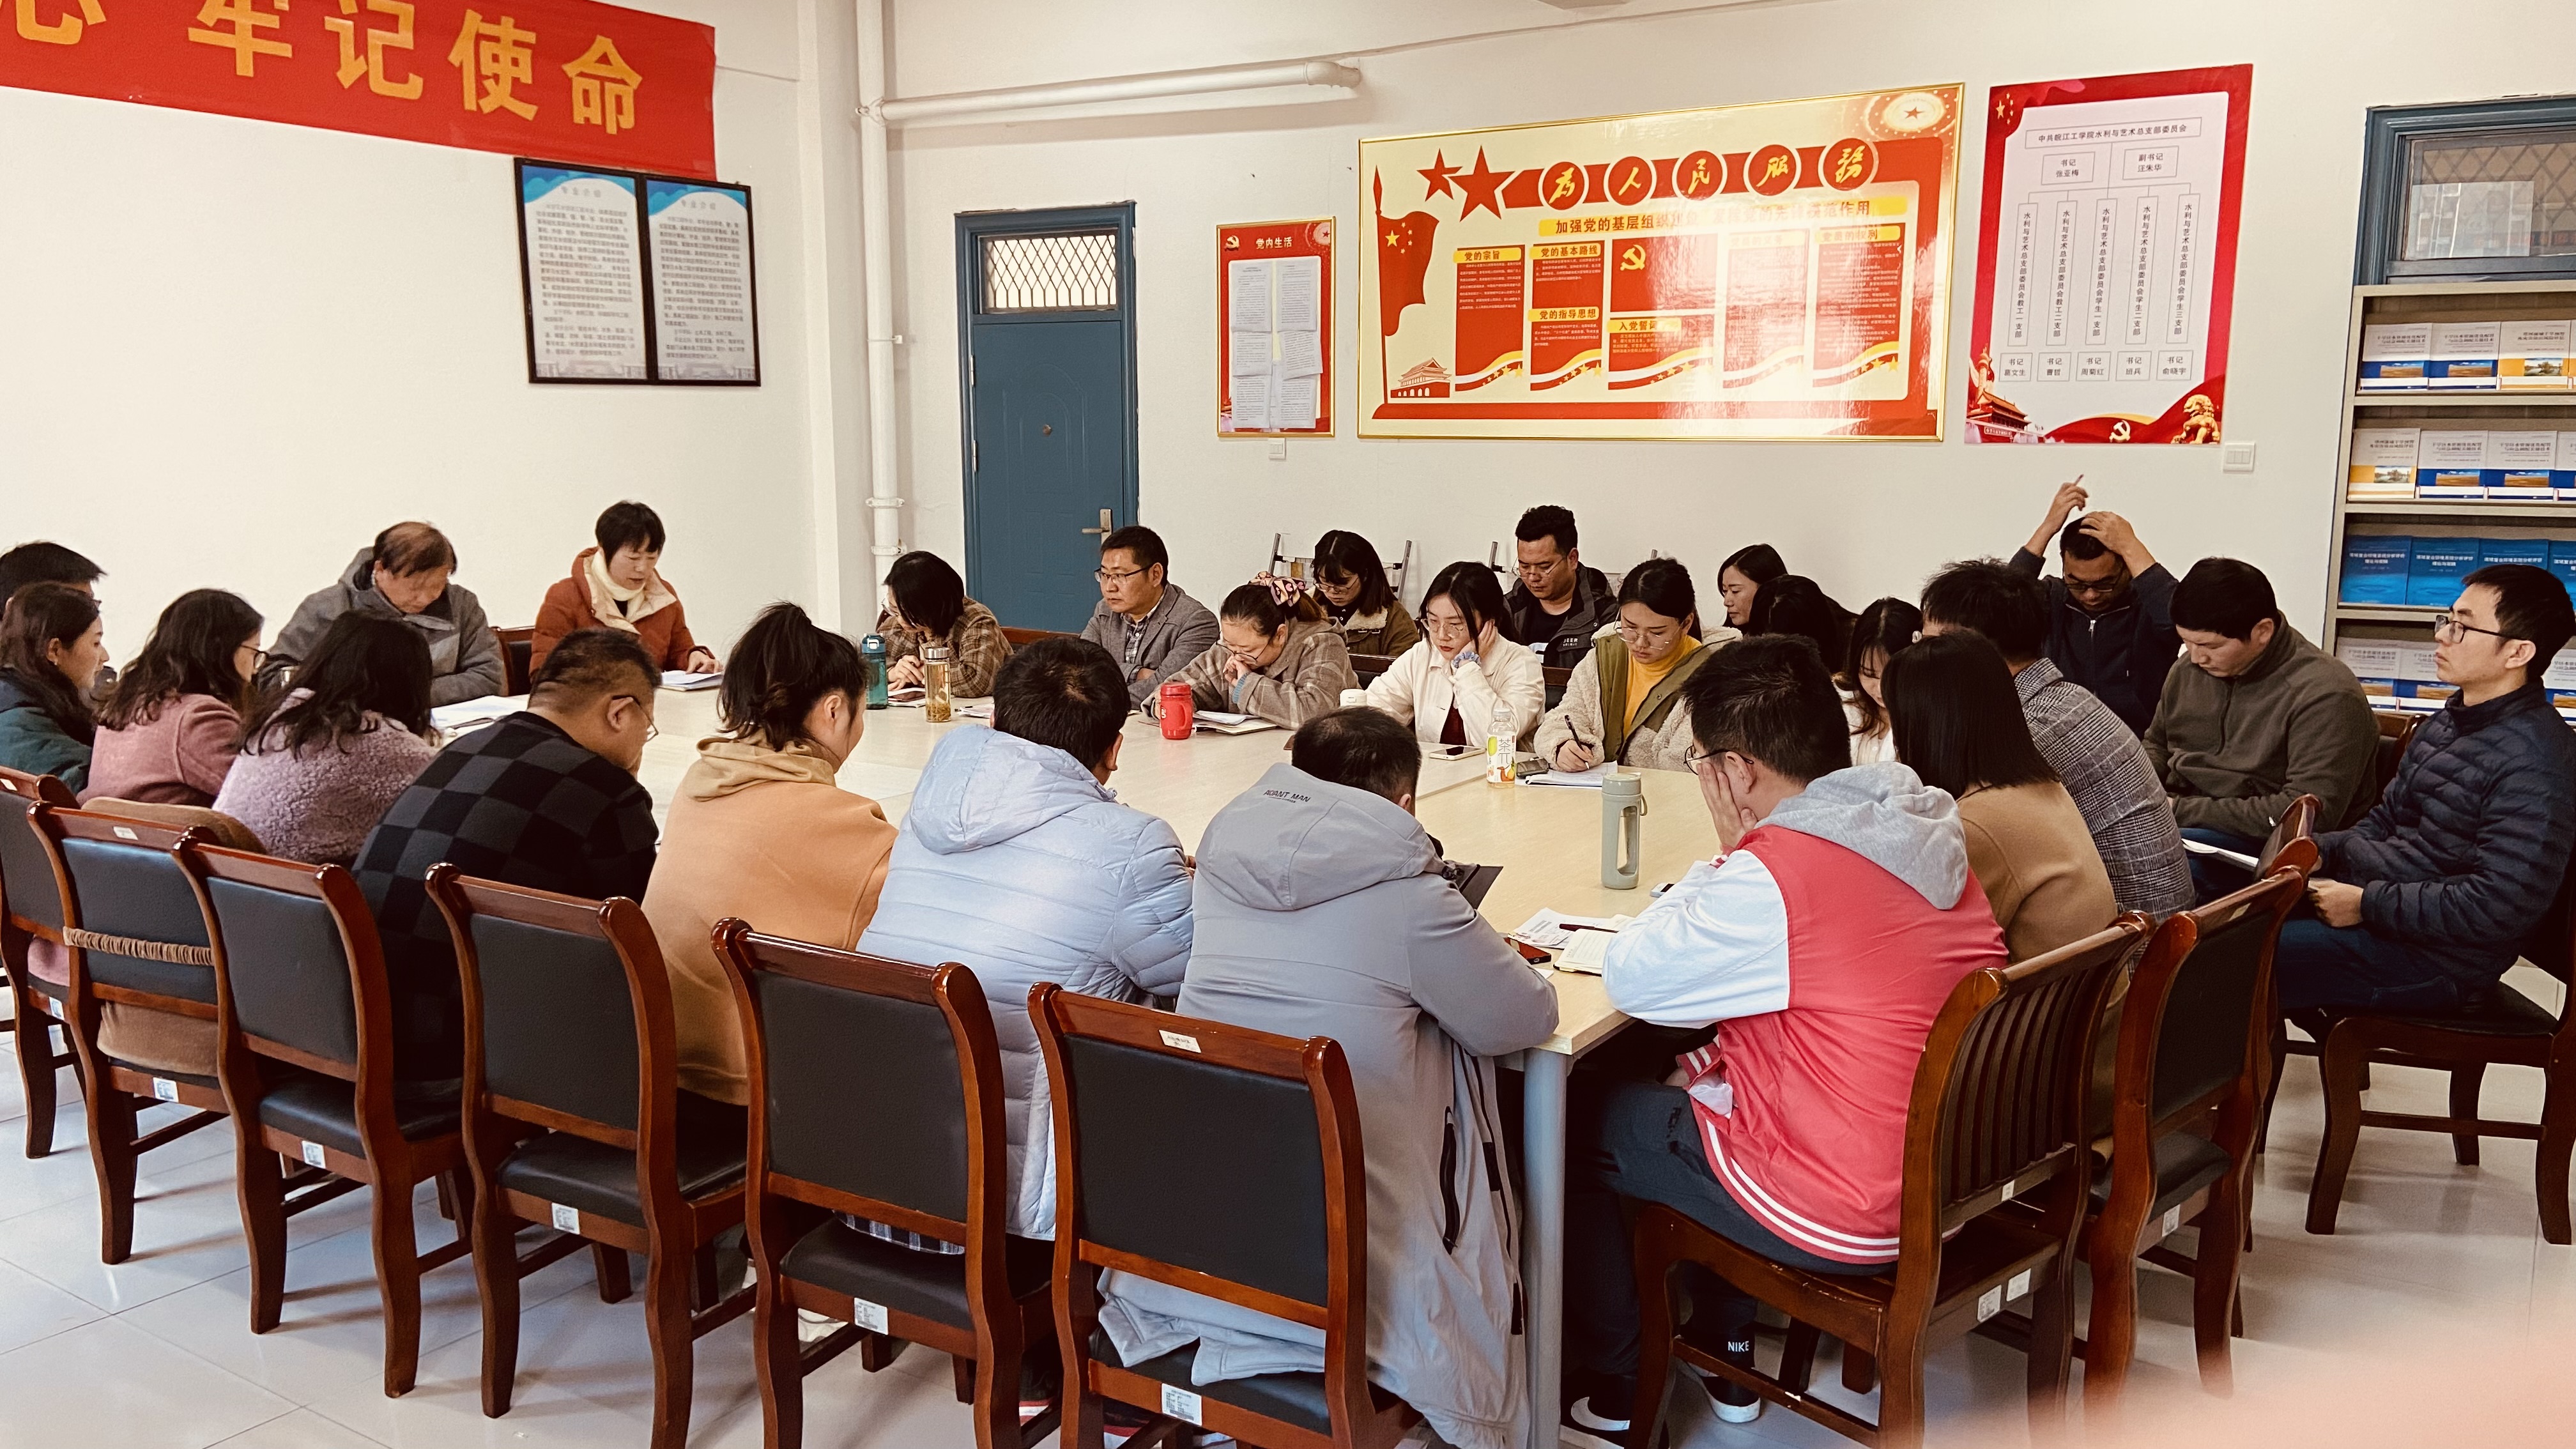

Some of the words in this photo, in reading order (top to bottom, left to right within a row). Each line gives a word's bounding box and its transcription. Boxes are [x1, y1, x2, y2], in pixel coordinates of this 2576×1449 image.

[188, 0, 642, 135] 牢记使命
[2060, 158, 2076, 167] 书记
[2138, 153, 2163, 162] 副书记
[1256, 236, 1293, 250] 党内生活
[1464, 250, 1500, 261] 党的宗旨
[1541, 245, 1598, 257] 党的基本路线
[1540, 308, 1597, 319] 党的指导思想
[2167, 356, 2183, 364] 书记
[1291, 793, 1312, 802] MAN
[1728, 1340, 1749, 1353] NIKE
